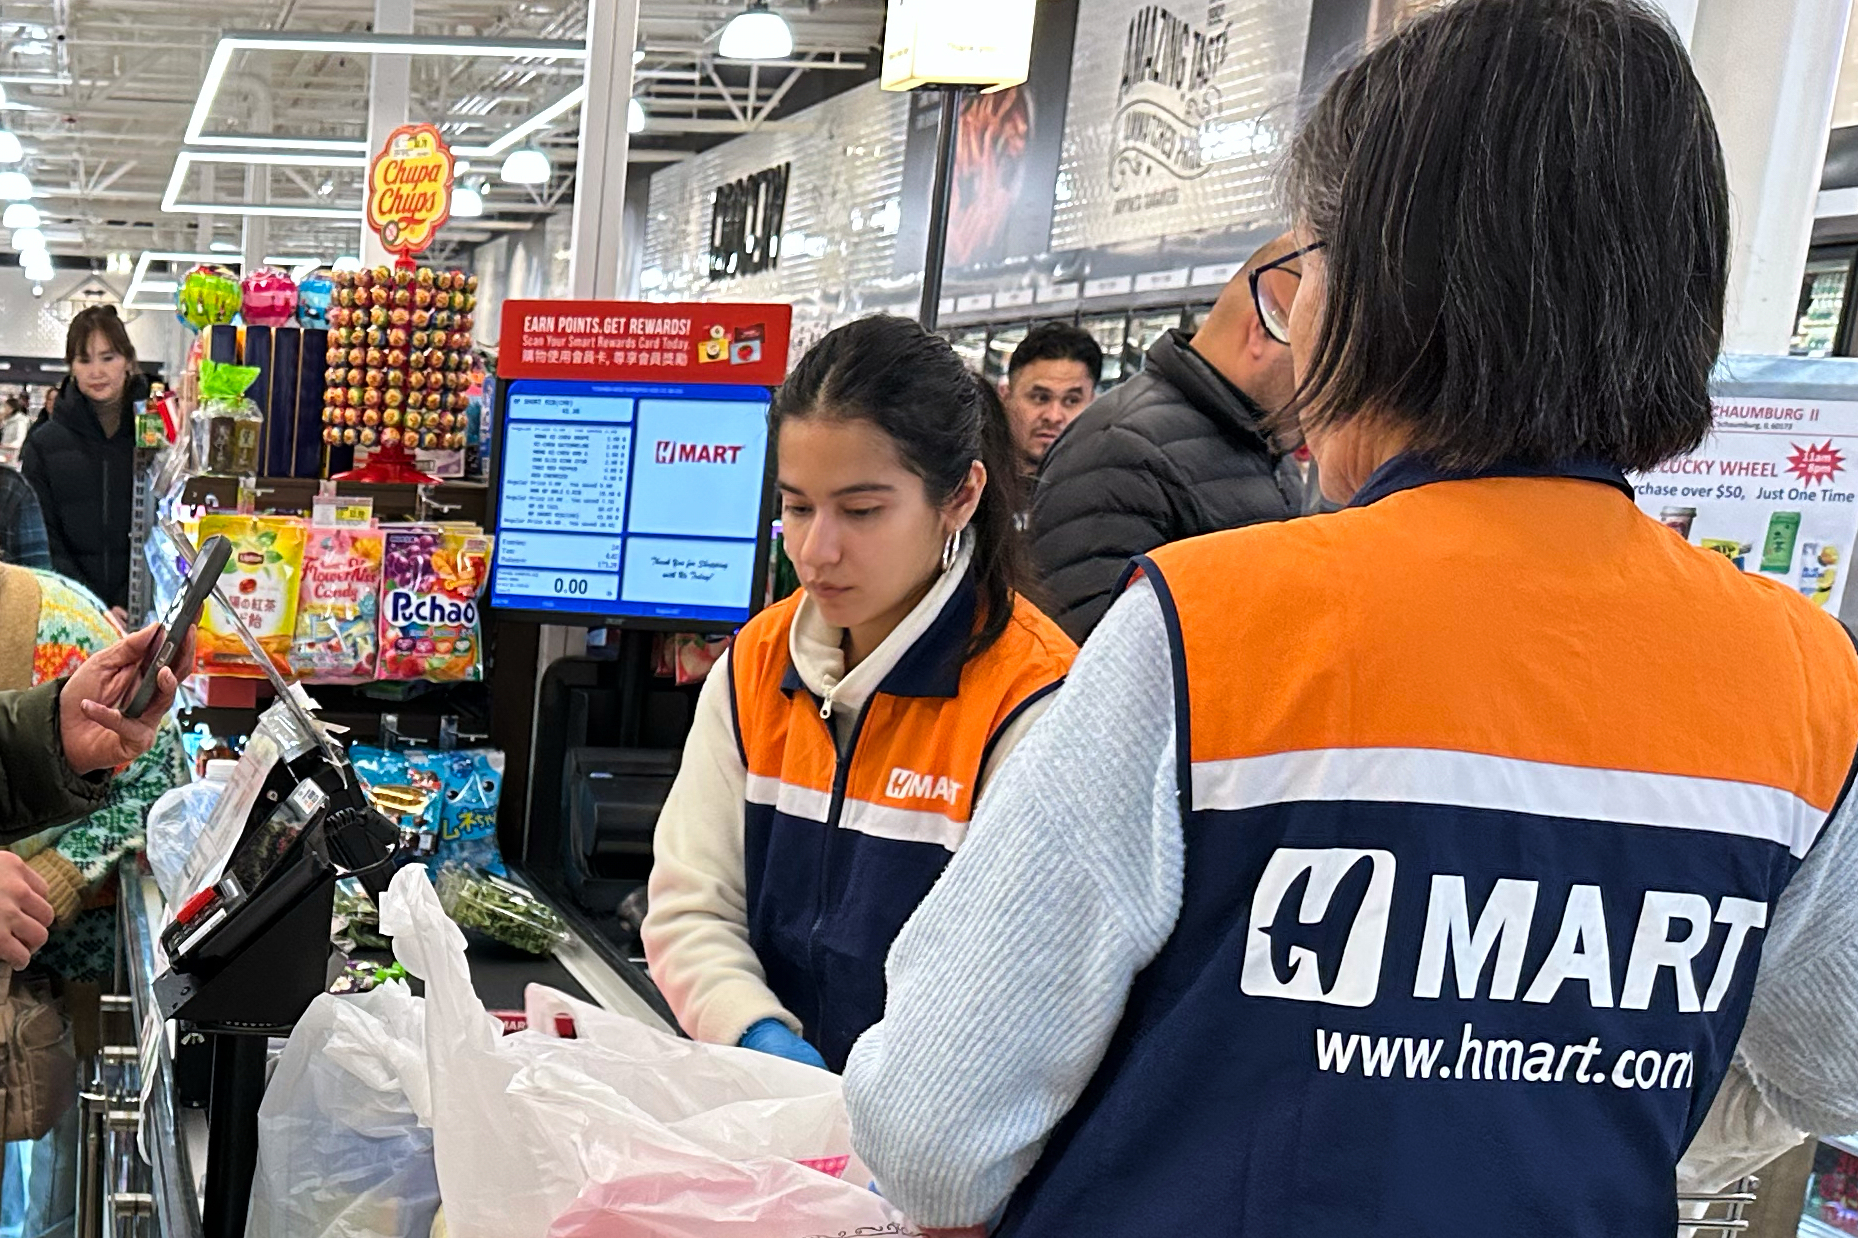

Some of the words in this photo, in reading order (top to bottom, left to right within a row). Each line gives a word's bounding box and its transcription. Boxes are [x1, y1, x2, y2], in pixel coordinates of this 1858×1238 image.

[383, 159, 443, 191] Chupa
[378, 187, 438, 220] Chups
[524, 316, 554, 333] EARN
[629, 318, 691, 336] REWARDS!
[522, 334, 544, 347] Scan
[546, 336, 566, 348] Your
[568, 336, 595, 348] Smart
[597, 337, 636, 349] Rewards
[638, 338, 660, 350] Card
[1711, 406, 1804, 421] CHAUMBURG
[679, 443, 746, 464] MART
[1802, 452, 1832, 463] 11am
[1720, 460, 1778, 477] WHEEL
[1633, 482, 1678, 497] rchase
[1681, 487, 1713, 497] over
[1716, 484, 1746, 500] $50,
[1756, 487, 1784, 500] Just
[1787, 488, 1817, 501] One
[1820, 489, 1855, 502] Time
[553, 577, 589, 595] 0.00
[393, 591, 475, 624] Puchao
[1413, 874, 1768, 1013] MART
